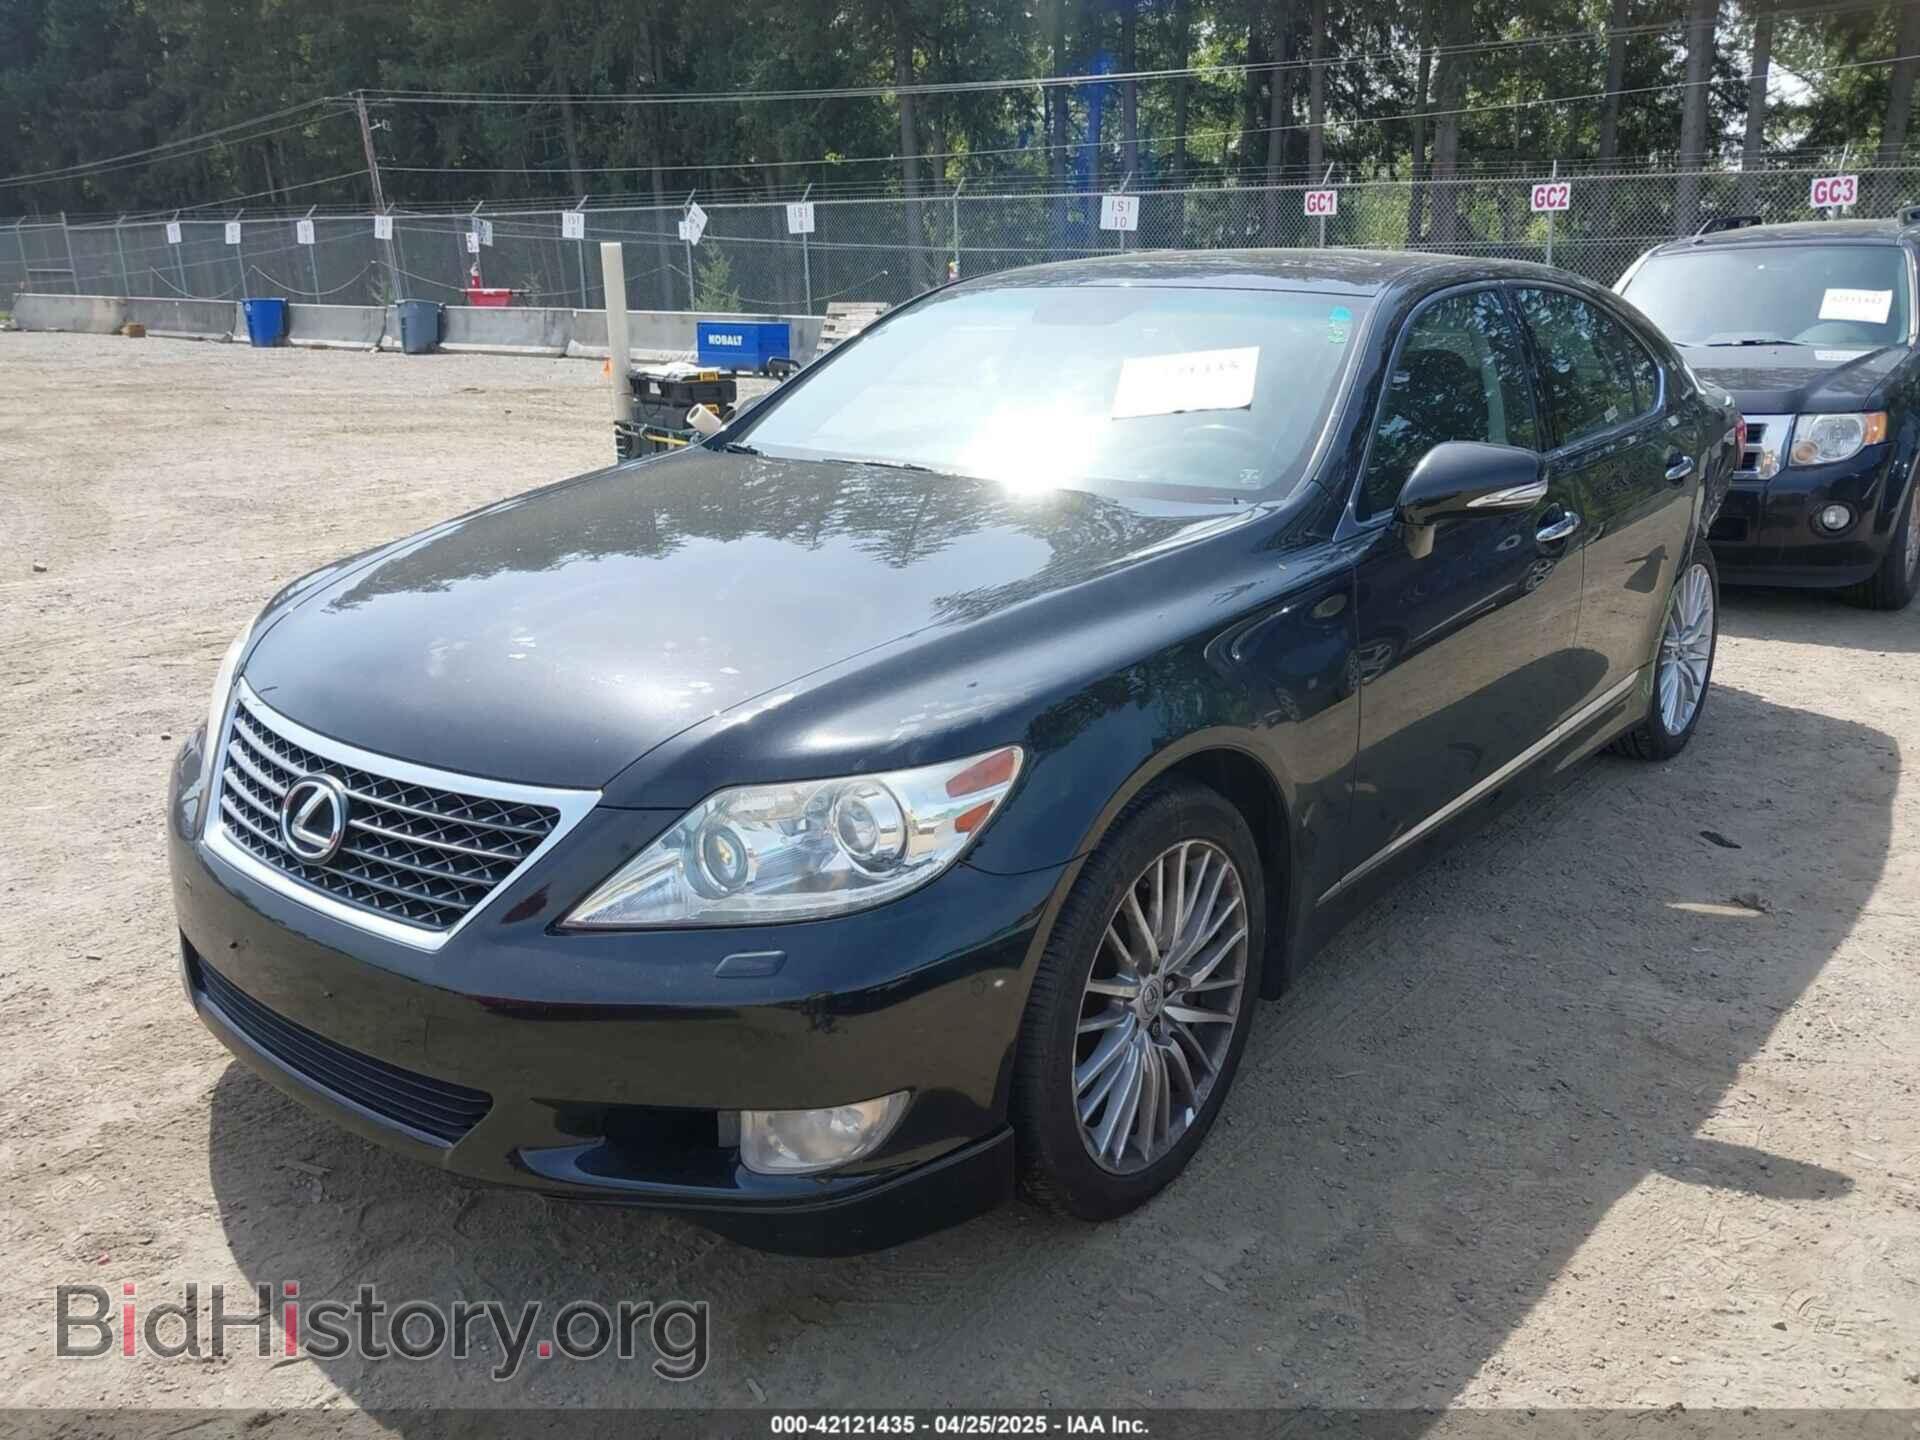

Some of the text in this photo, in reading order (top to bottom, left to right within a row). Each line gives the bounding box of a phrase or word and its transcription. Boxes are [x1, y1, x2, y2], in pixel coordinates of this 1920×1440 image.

[1533, 186, 1569, 207] GC2
[1814, 179, 1855, 203] GC3
[1306, 194, 1335, 213] GC1
[708, 334, 743, 347] KOBALT
